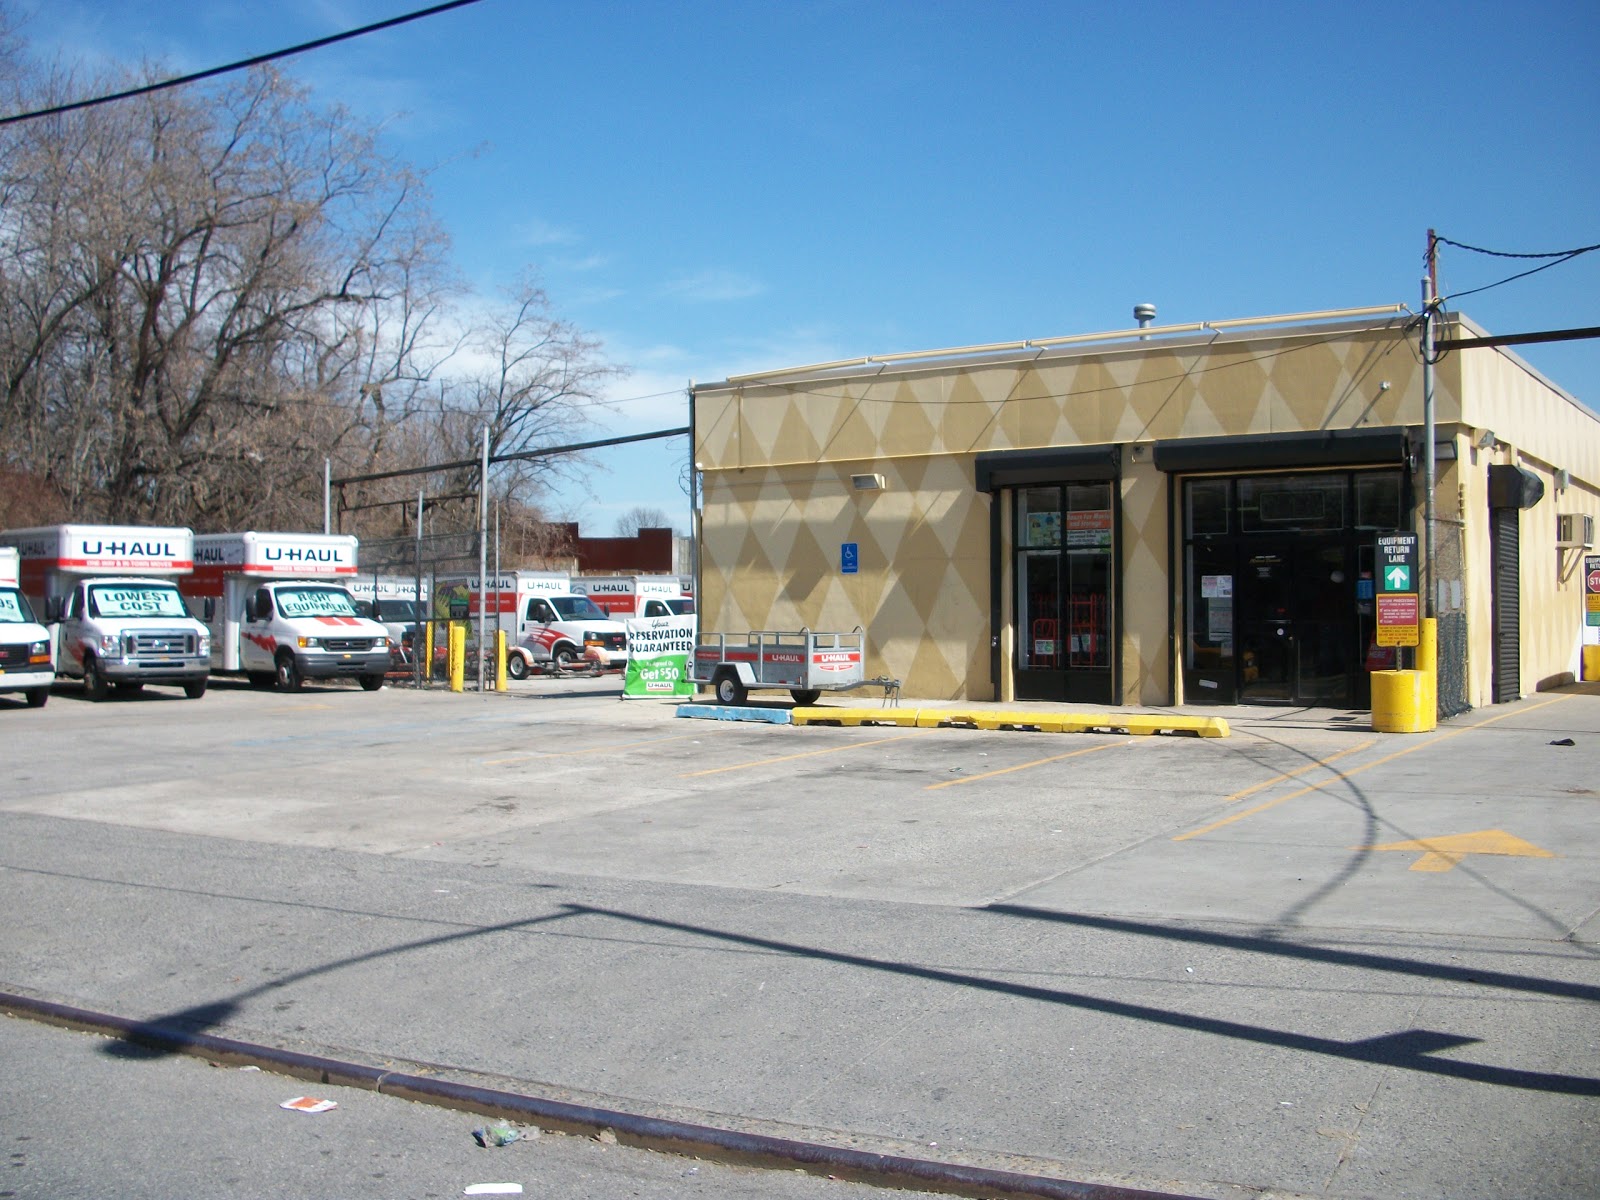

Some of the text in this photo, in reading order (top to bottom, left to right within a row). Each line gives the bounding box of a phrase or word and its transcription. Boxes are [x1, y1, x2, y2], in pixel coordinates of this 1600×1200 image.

[1378, 536, 1415, 545] EQUIPMENT
[83, 541, 175, 556] U-HAUL
[1383, 545, 1410, 554] RETURN
[266, 547, 343, 562] U-HAUL
[1388, 554, 1405, 563] LANE
[527, 581, 562, 590] U-HAUL
[1590, 577, 1600, 586] ST
[593, 584, 630, 592] U-HAUL
[642, 585, 673, 593] U-HAUL
[104, 591, 170, 602] LOWEST
[298, 592, 331, 602] RIGHT
[120, 602, 160, 611] COST
[629, 628, 693, 641] RESERVATION
[629, 641, 693, 652] GUARANTEED
[772, 654, 799, 662] U-HAUL
[821, 654, 850, 663] U-HAUL
[641, 667, 679, 680] Get $50
